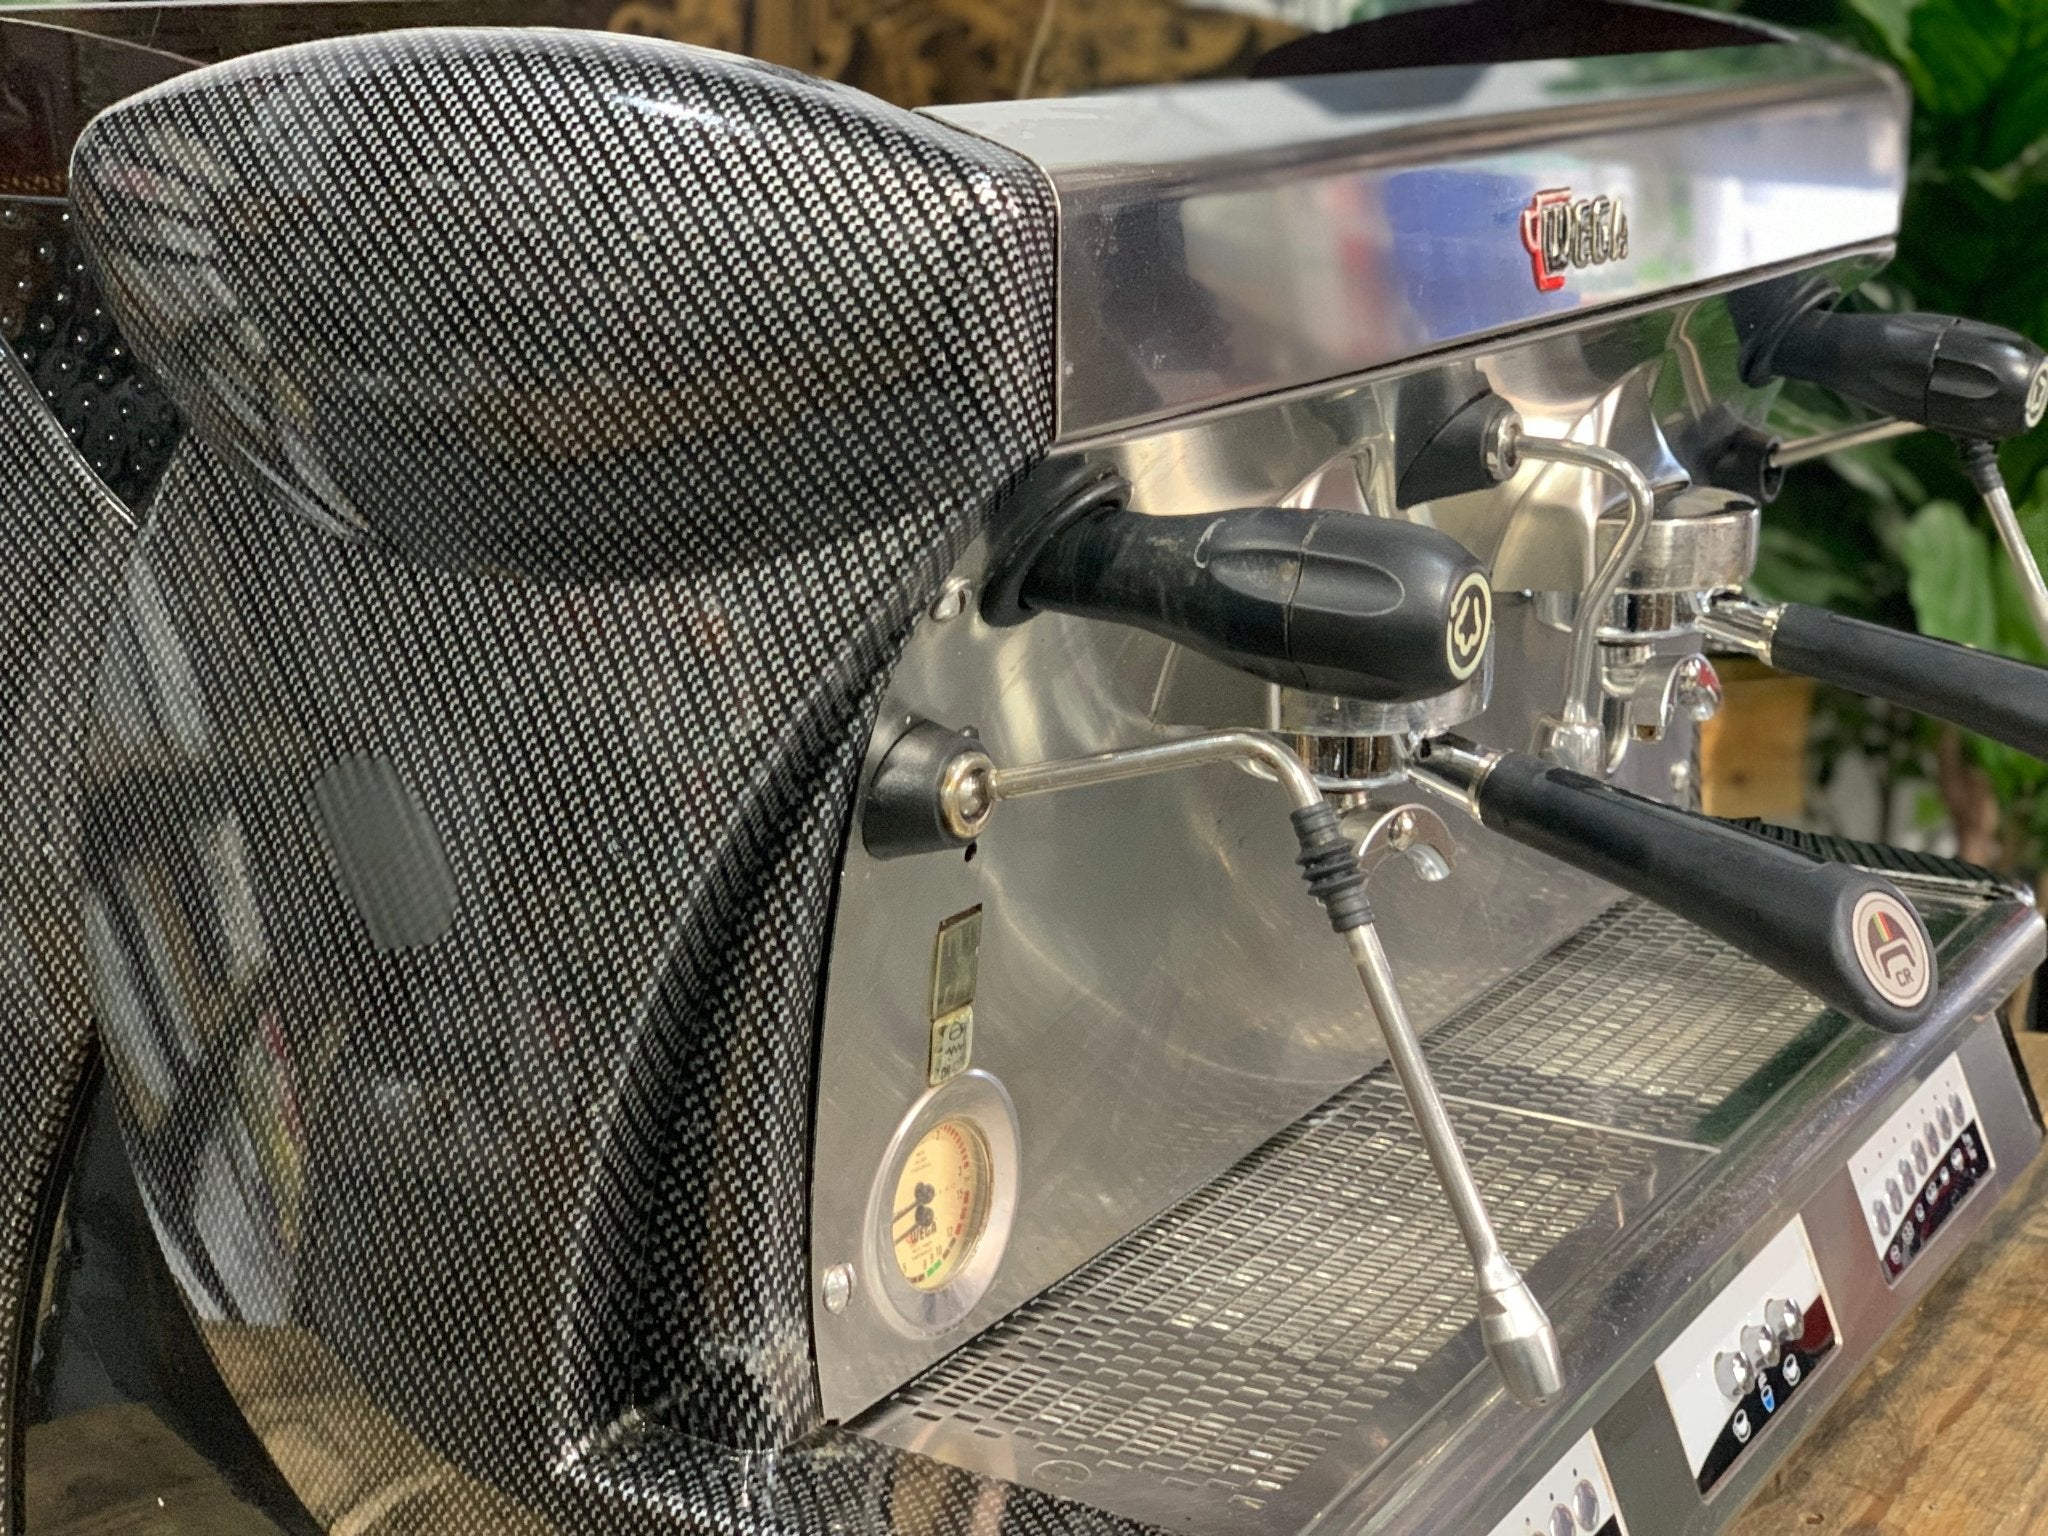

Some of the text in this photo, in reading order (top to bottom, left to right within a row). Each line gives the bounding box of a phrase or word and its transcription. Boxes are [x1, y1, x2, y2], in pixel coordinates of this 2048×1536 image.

[1541, 195, 1628, 275] WEGA
[1895, 967, 1914, 987] CR
[911, 1221, 937, 1244] WEGA
